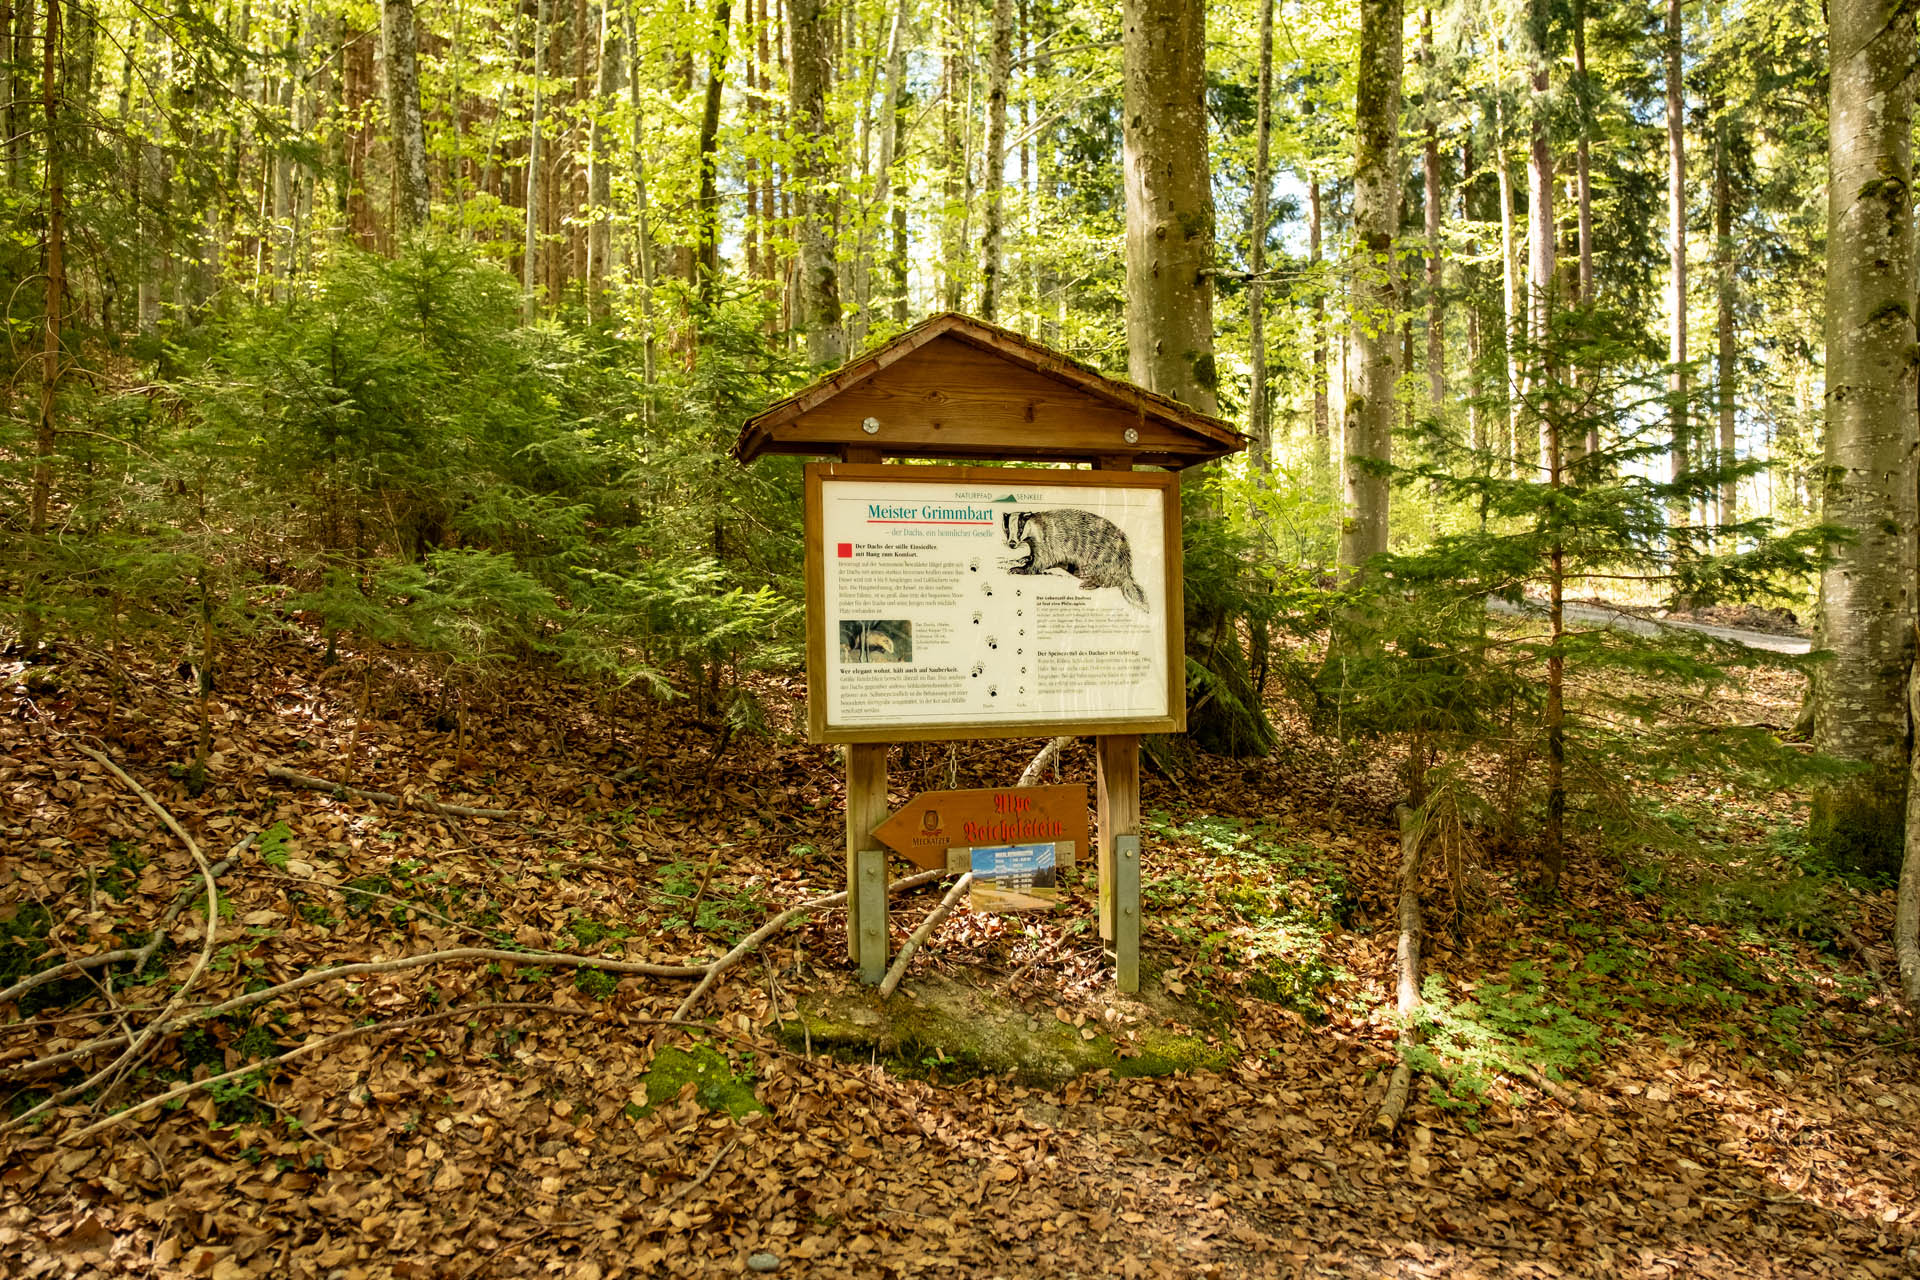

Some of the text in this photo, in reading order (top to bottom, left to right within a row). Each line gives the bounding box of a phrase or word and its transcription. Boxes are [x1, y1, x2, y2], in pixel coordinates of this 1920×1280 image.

[955, 492, 992, 500] NATURPFAD
[868, 504, 993, 521] Meister Grimmbart
[891, 529, 903, 537] der
[993, 792, 1032, 816] Alpe
[912, 837, 950, 847] MECKATZER
